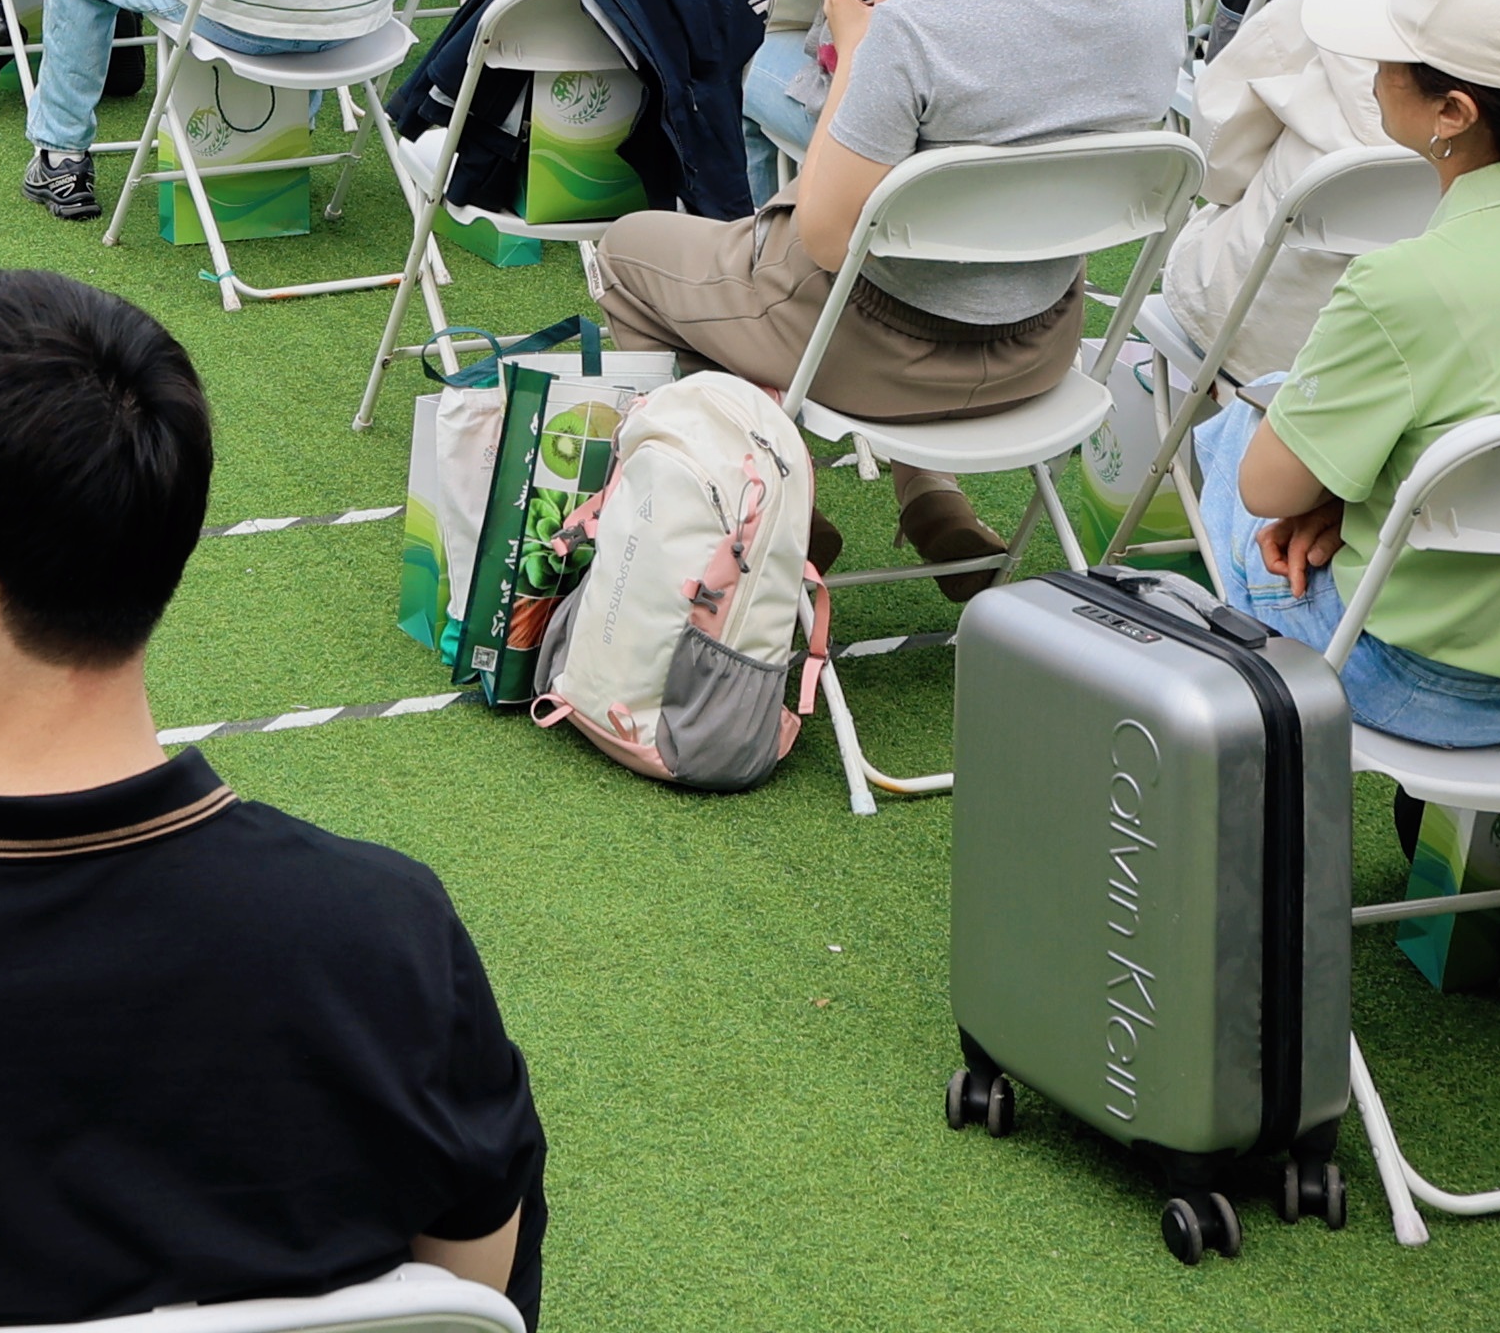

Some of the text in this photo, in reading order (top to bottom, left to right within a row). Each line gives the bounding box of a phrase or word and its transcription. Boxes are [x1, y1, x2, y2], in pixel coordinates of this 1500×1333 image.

[603, 534, 639, 646] LRD SPORTS CLUB
[1106, 718, 1162, 1123] Calvin Klein
